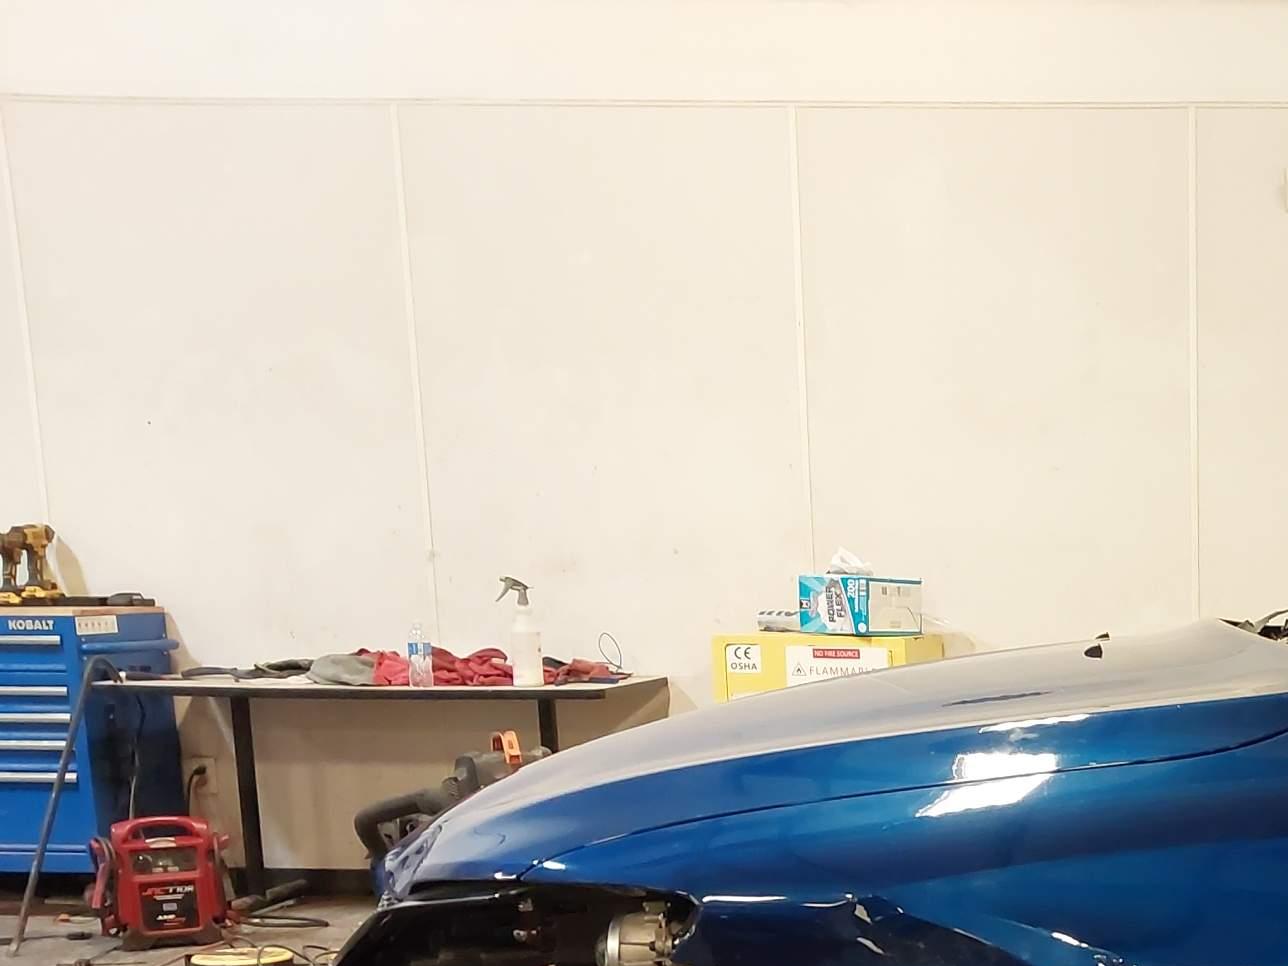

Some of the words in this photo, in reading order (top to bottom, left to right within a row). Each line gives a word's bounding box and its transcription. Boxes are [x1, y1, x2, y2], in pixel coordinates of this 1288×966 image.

[826, 587, 836, 622] POWER
[835, 592, 845, 618] FLEX
[8, 619, 54, 630] KOBALT
[734, 646, 751, 659] CE
[837, 650, 859, 658] SOURCE
[731, 662, 757, 671] OSHA
[809, 666, 875, 676] FLAMMAB
